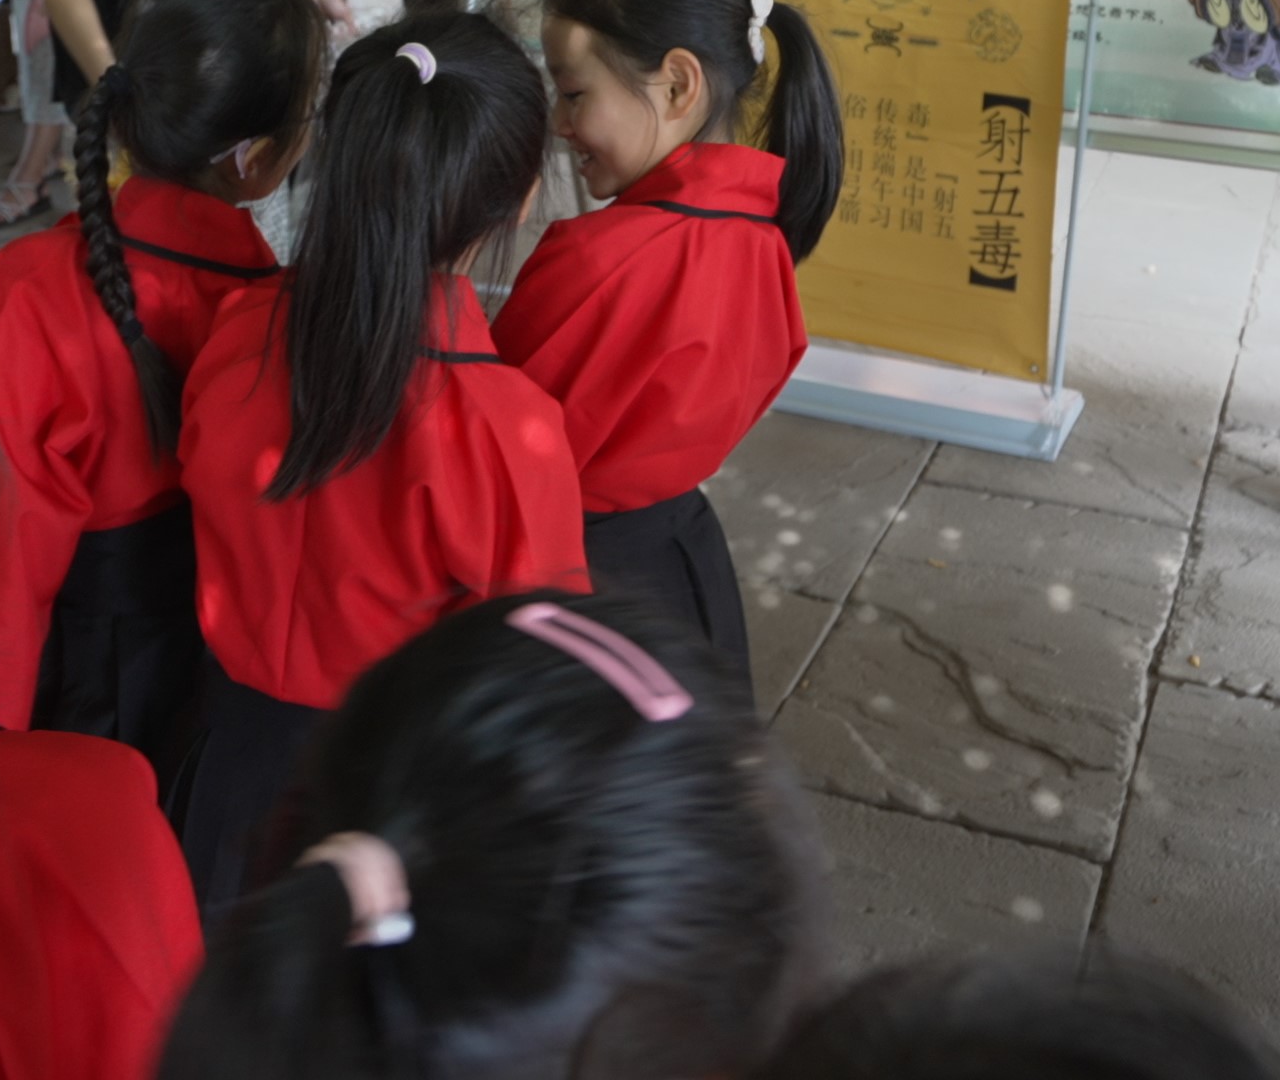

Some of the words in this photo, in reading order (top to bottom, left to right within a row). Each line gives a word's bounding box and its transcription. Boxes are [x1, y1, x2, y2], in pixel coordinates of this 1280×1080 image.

[869, 97, 898, 229] 传统端午习
[968, 91, 1032, 293] 【射五毒】
